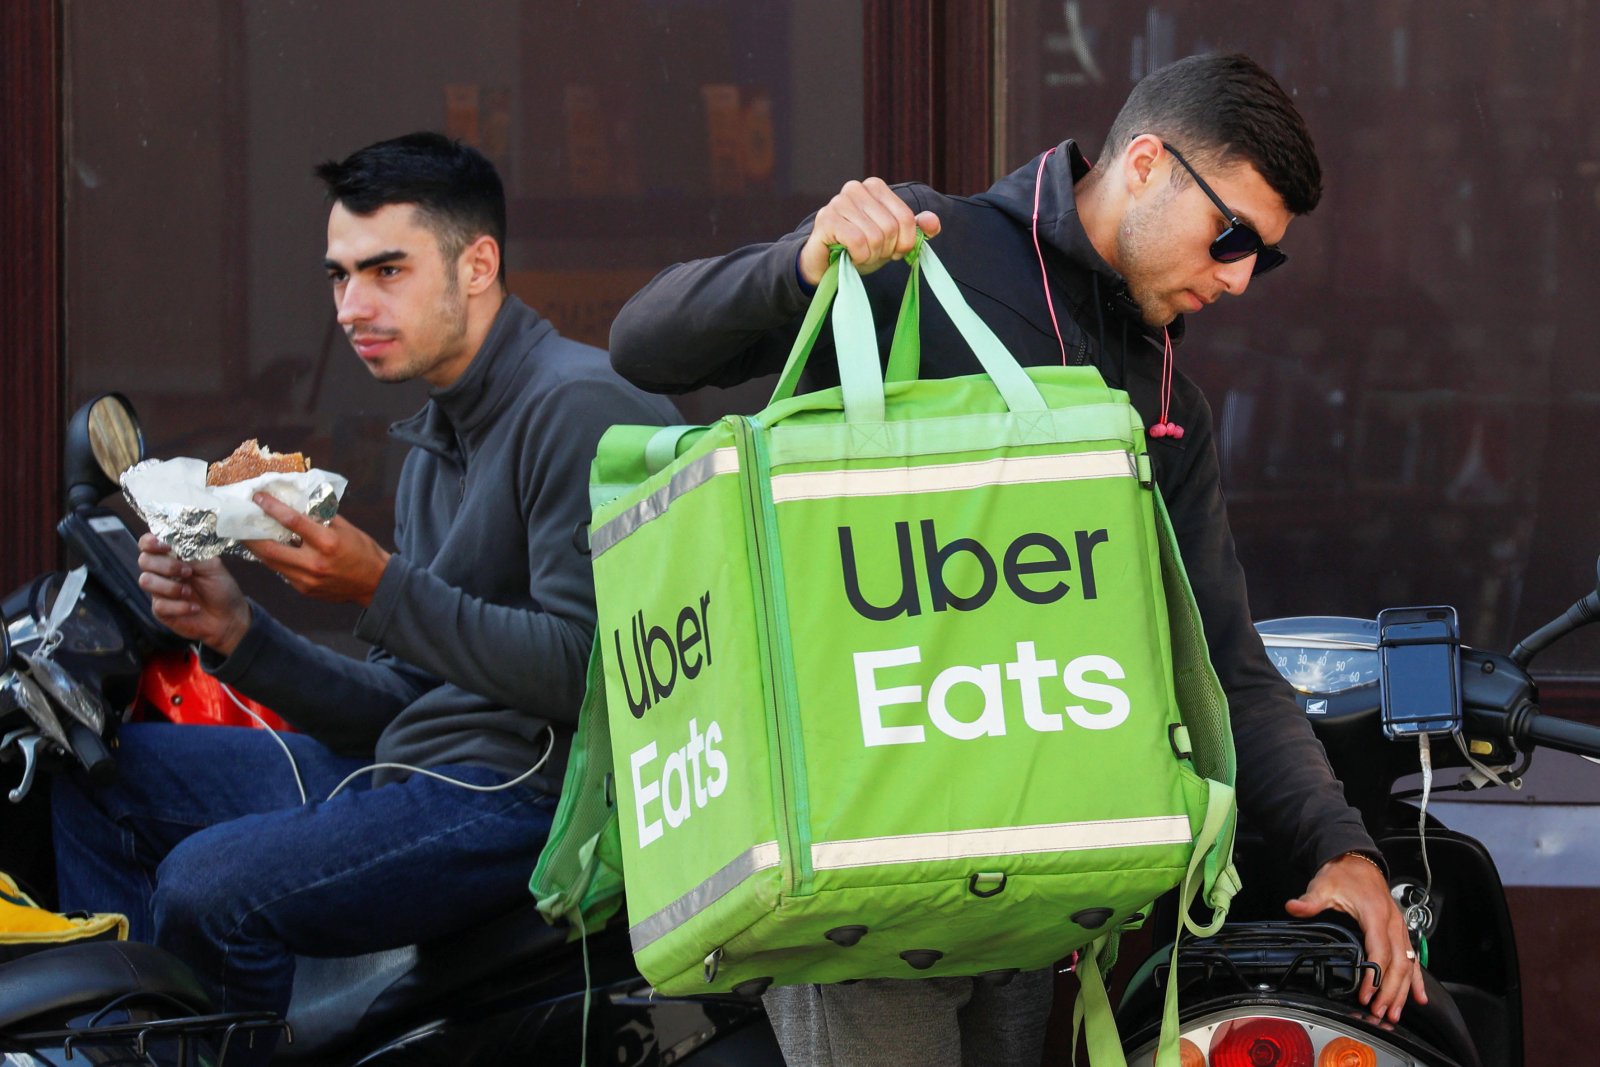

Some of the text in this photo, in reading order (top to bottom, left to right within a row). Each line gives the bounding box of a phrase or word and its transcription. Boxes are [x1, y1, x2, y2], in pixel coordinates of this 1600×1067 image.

[838, 520, 1108, 620] Uber
[614, 592, 711, 718] Uber
[853, 641, 1130, 747] Eats
[1277, 654, 1360, 683] 20 30 40 50 60
[631, 718, 728, 848] Eats
